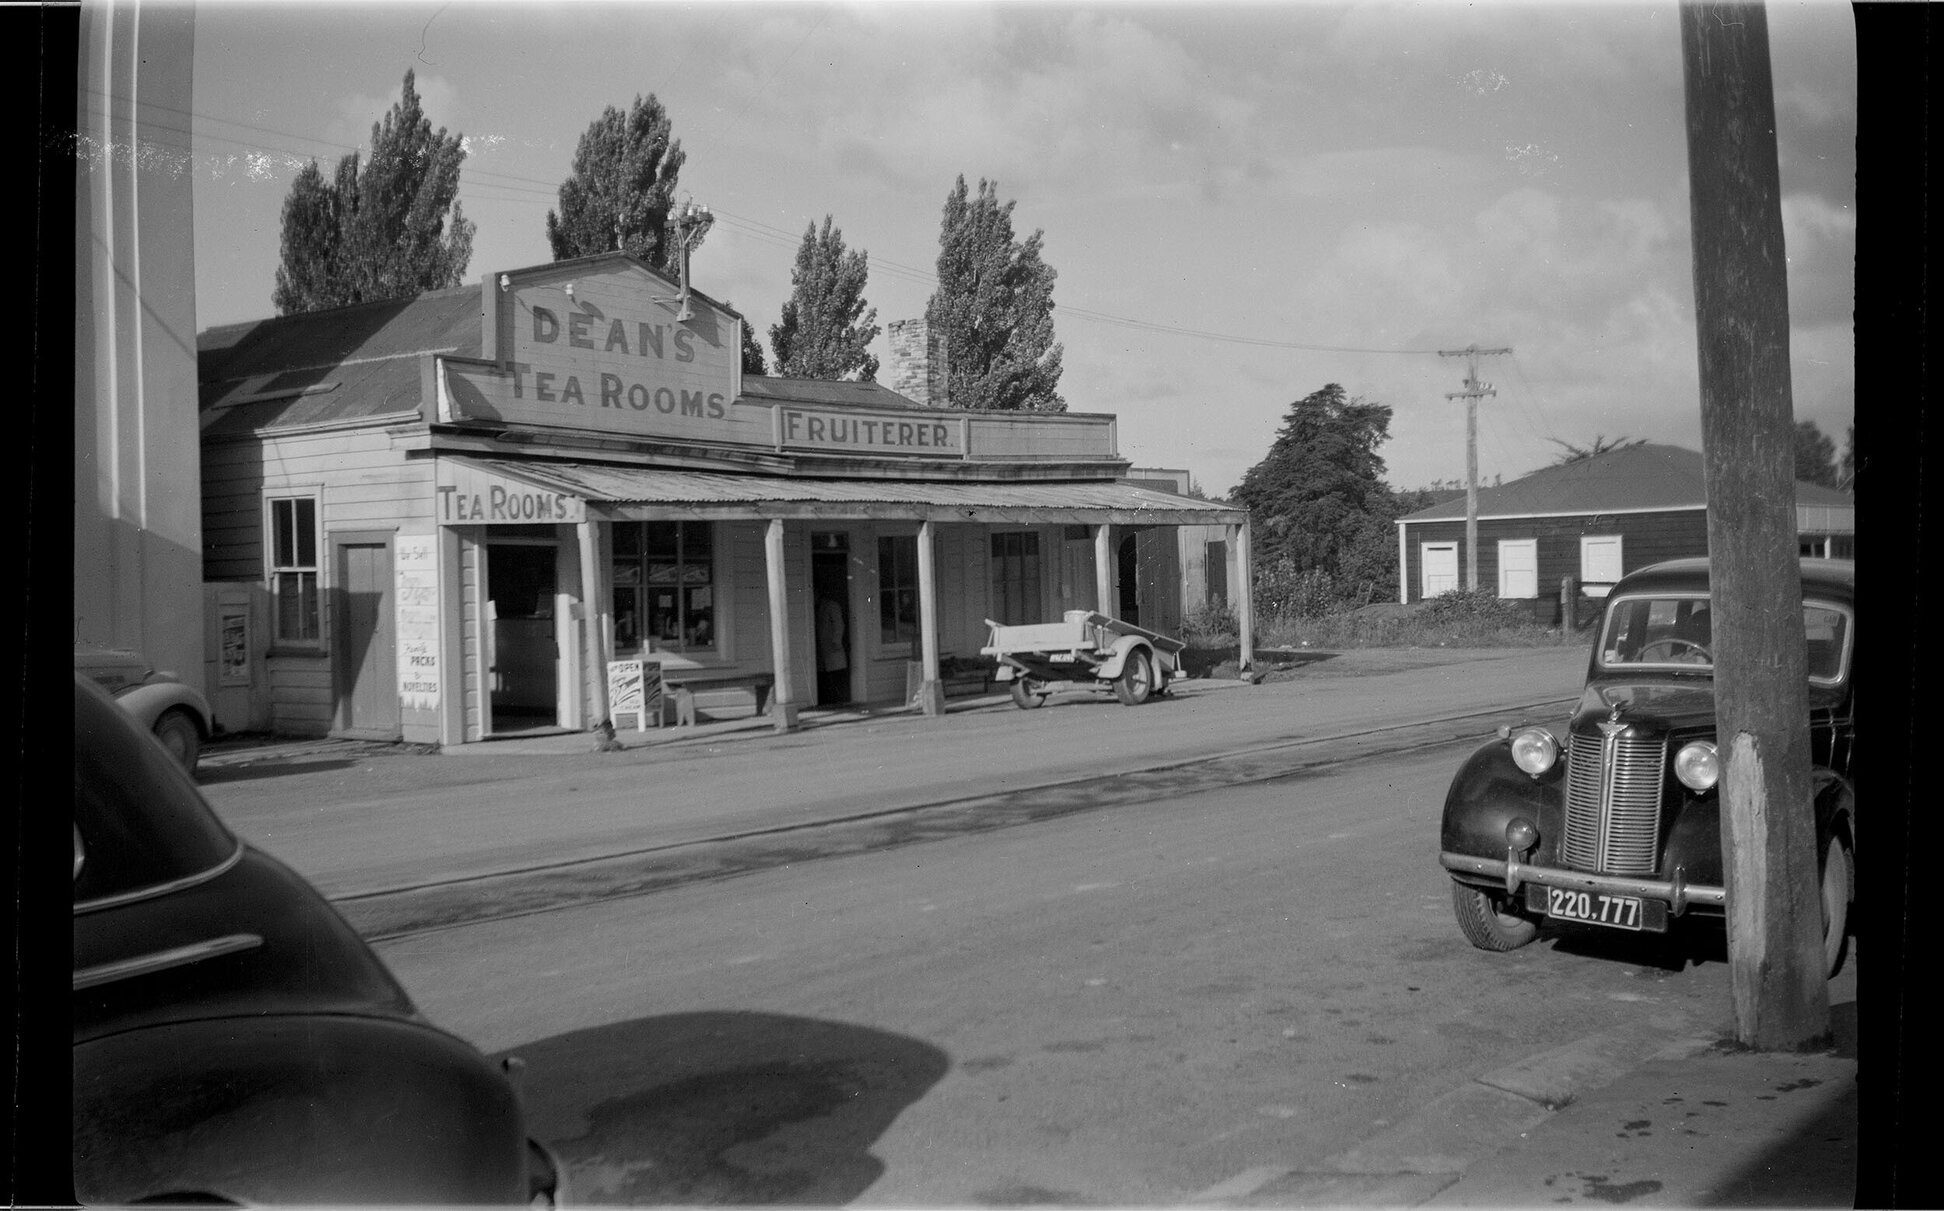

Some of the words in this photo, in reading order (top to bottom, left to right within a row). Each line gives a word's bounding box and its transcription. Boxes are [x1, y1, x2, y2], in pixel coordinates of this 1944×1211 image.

[533, 305, 695, 363] DEAN'S
[505, 361, 585, 405] TEA
[601, 372, 725, 419] ROOMS
[438, 485, 484, 520] TEA
[403, 681, 437, 693] NOVELTIES
